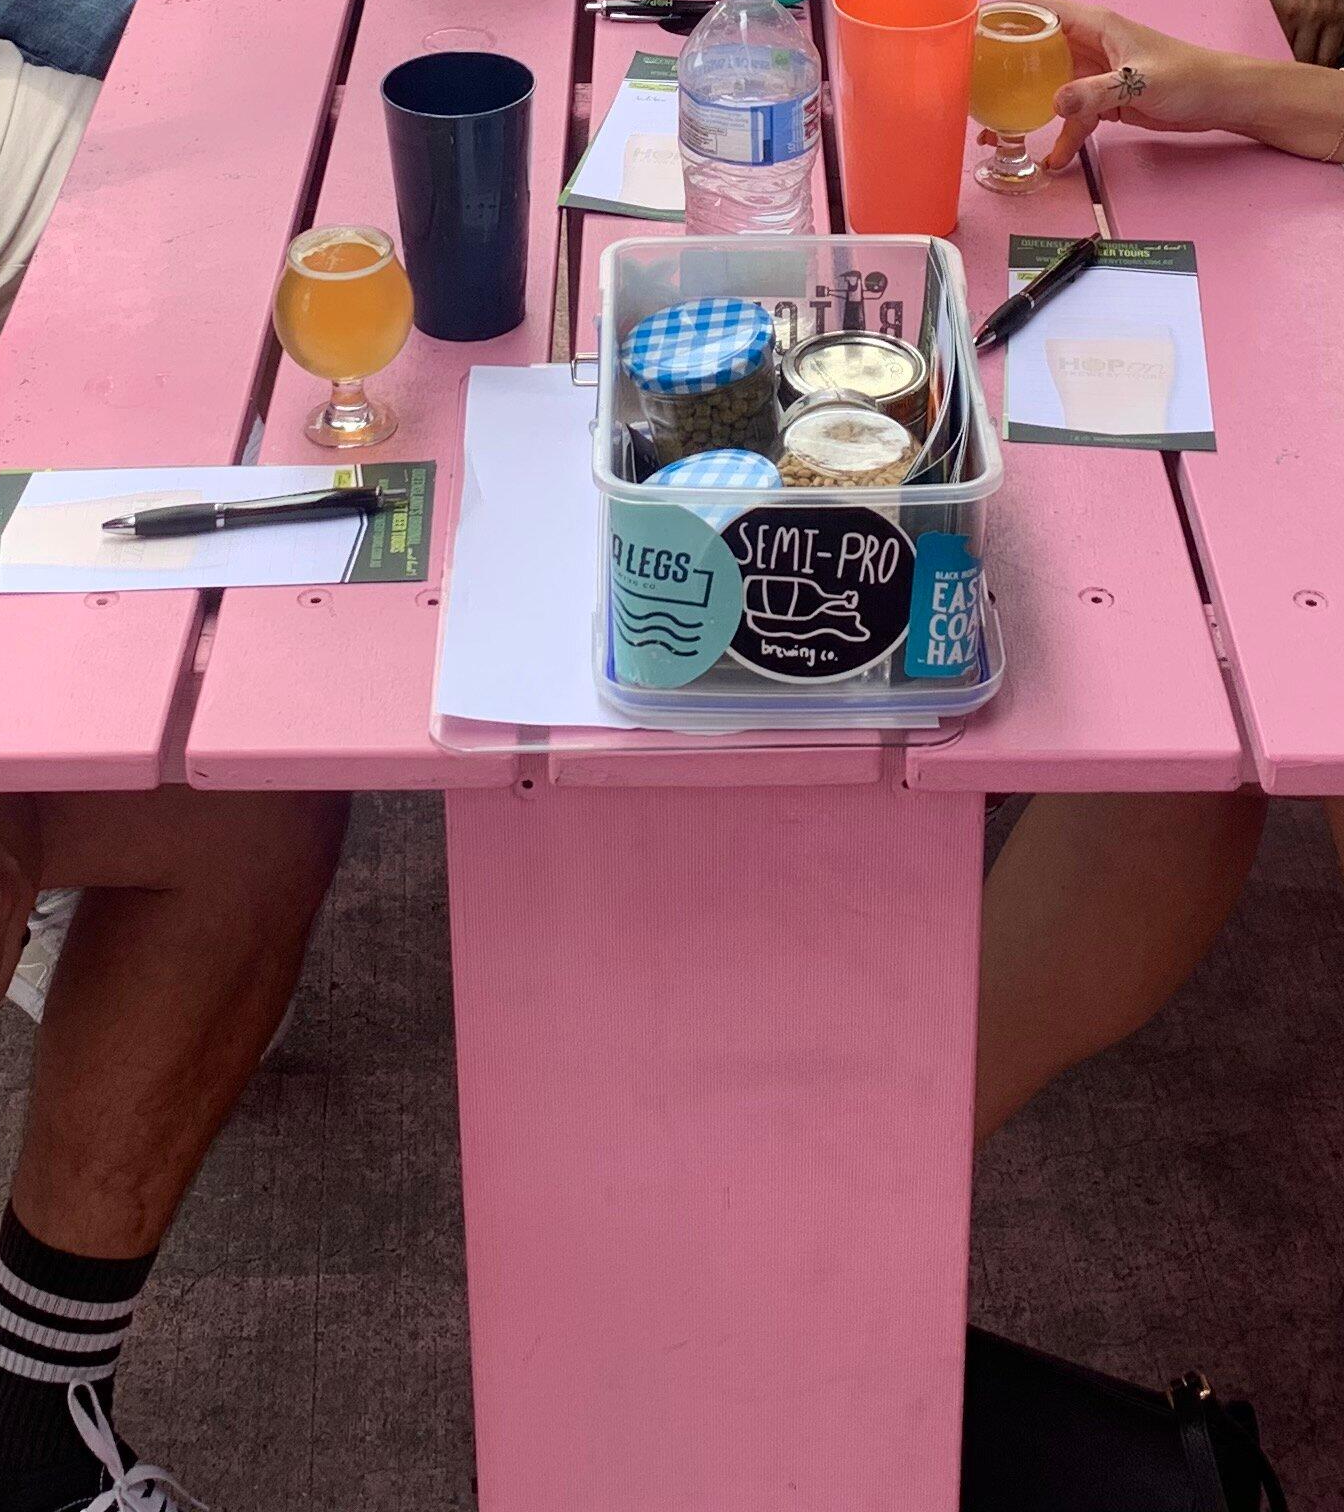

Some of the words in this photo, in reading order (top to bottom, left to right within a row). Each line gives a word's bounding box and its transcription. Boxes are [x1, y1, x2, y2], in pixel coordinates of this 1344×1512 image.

[1118, 249, 1151, 258] TOURS
[625, 543, 691, 584] LEGS
[736, 521, 900, 585] SEMI-PRO
[935, 570, 959, 581] BLACK
[761, 638, 816, 667] brewing
